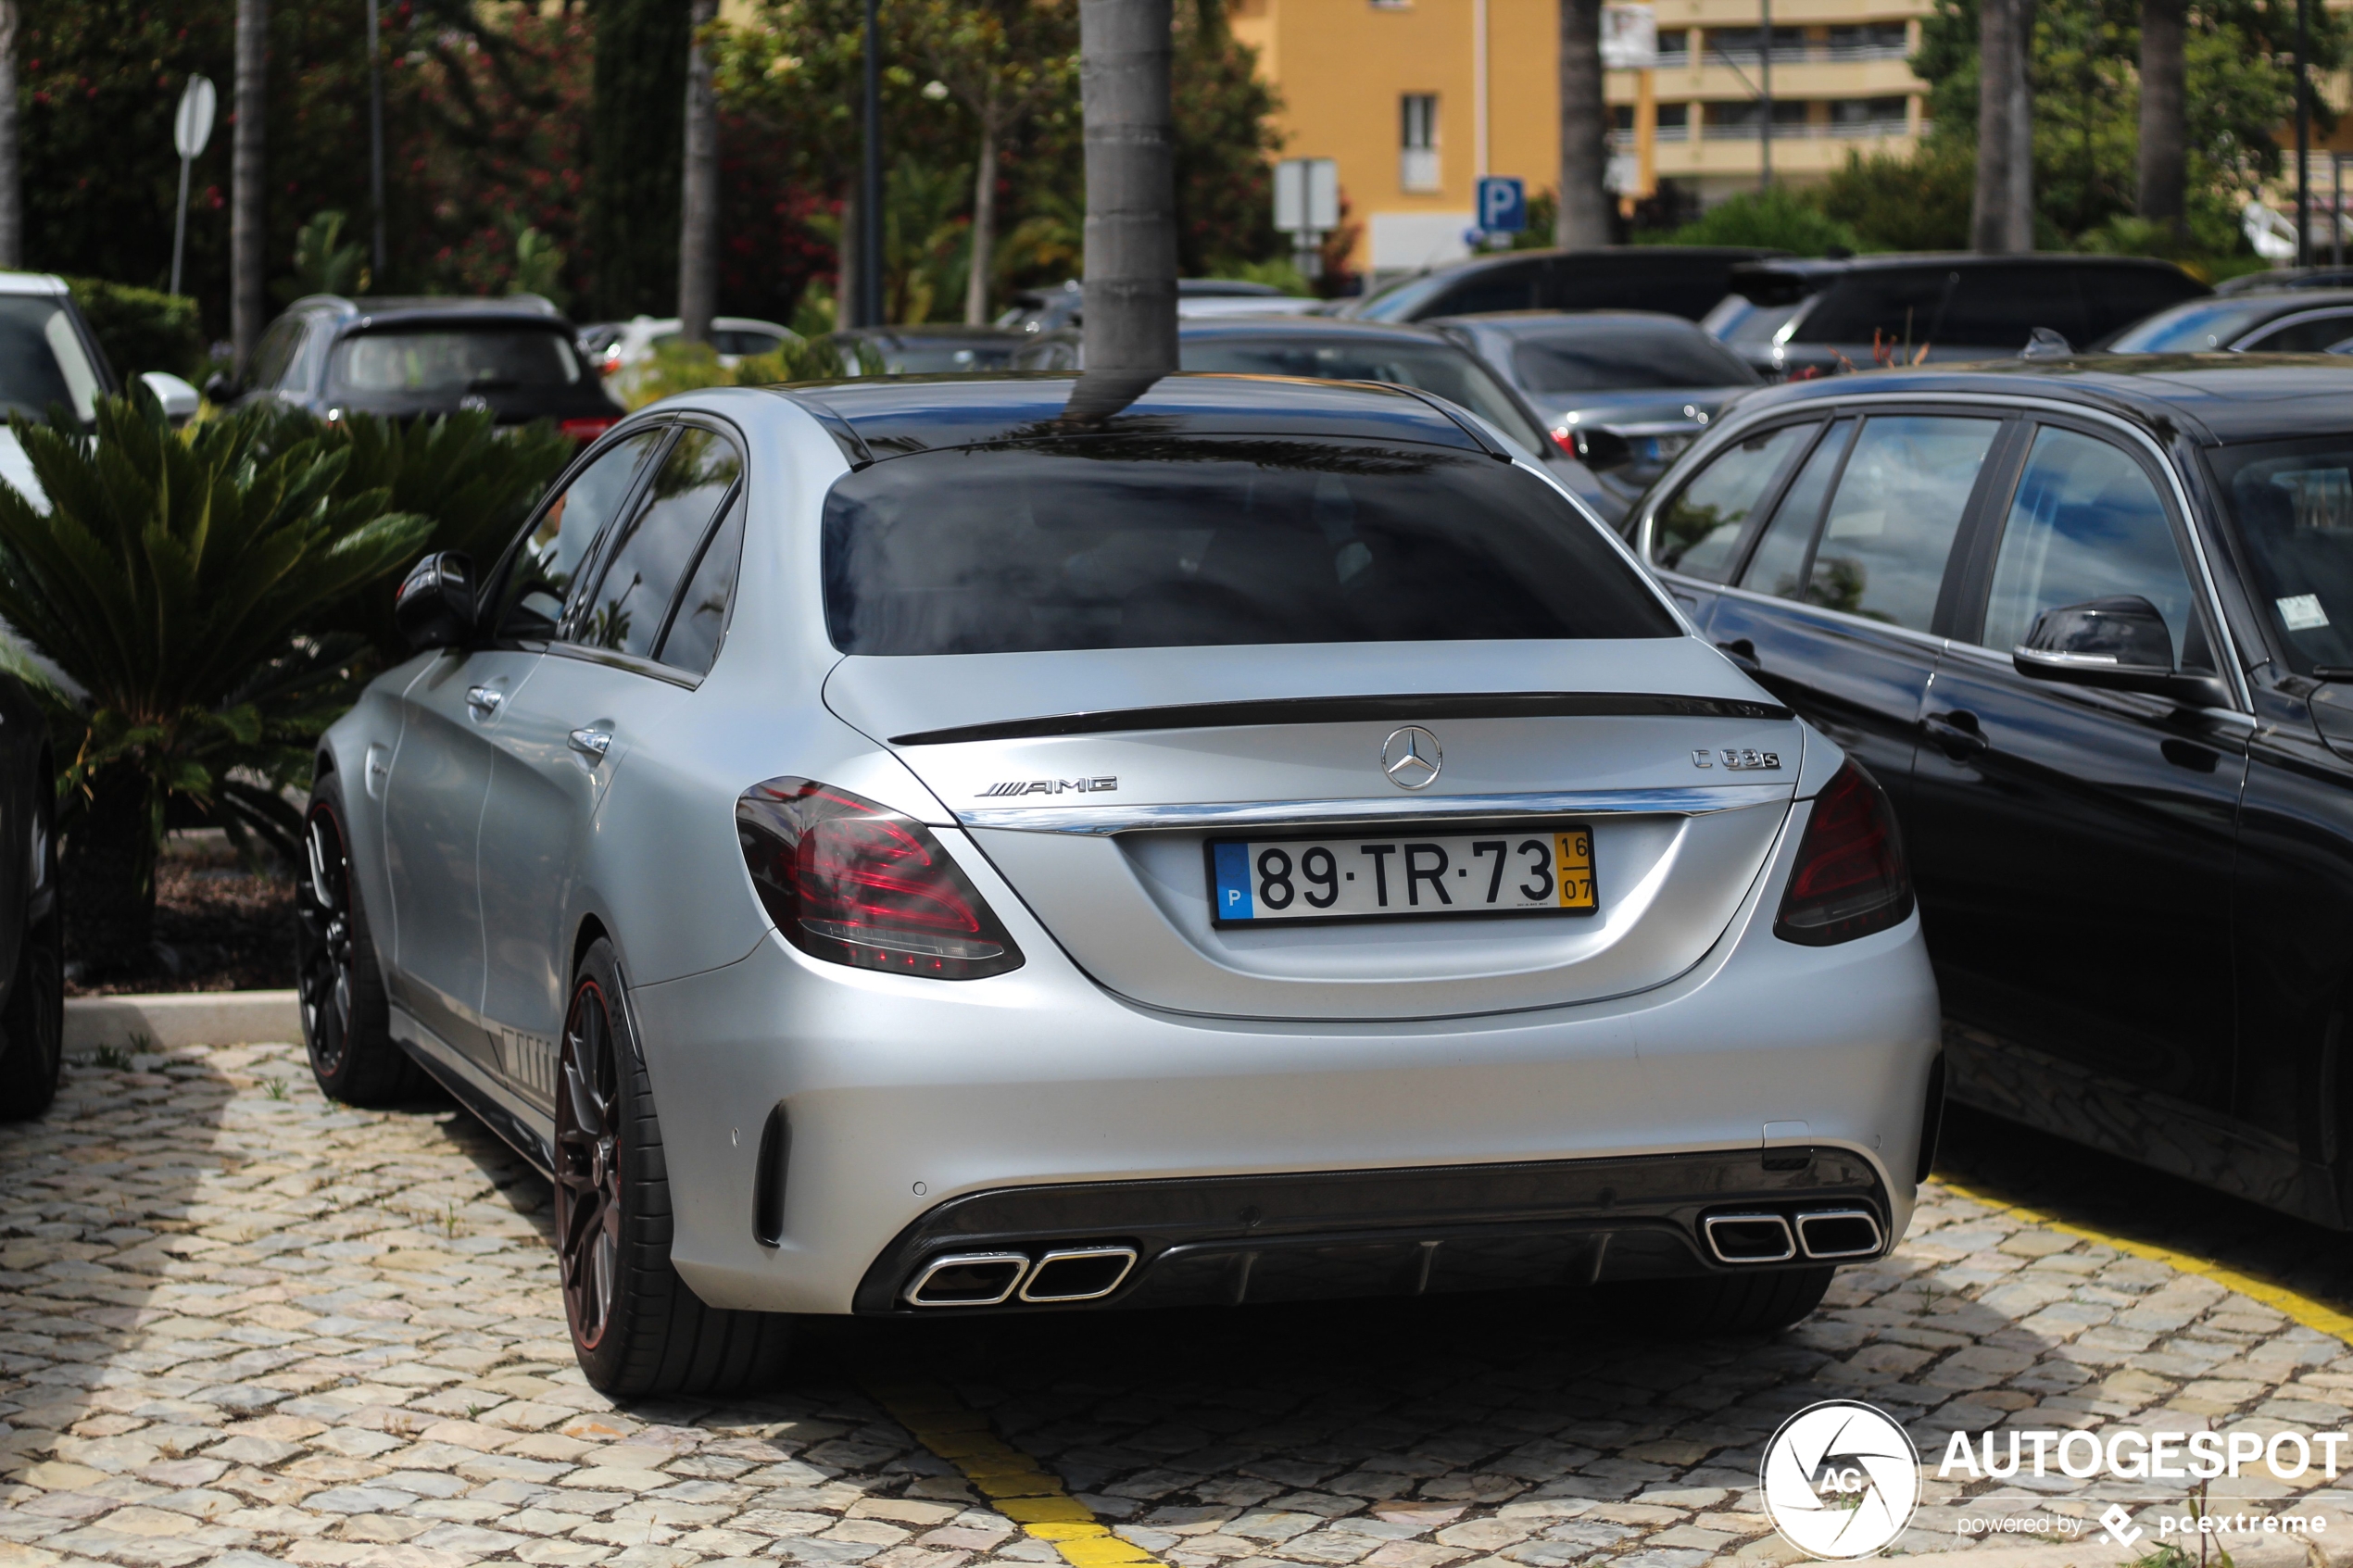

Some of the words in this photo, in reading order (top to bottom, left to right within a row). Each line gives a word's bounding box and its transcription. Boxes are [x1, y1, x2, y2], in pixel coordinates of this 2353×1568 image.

[1486, 183, 1516, 225] P
[1692, 749, 1713, 768] C
[1562, 836, 1588, 859] 16
[1228, 889, 1241, 907] P
[1564, 878, 1592, 900] 07
